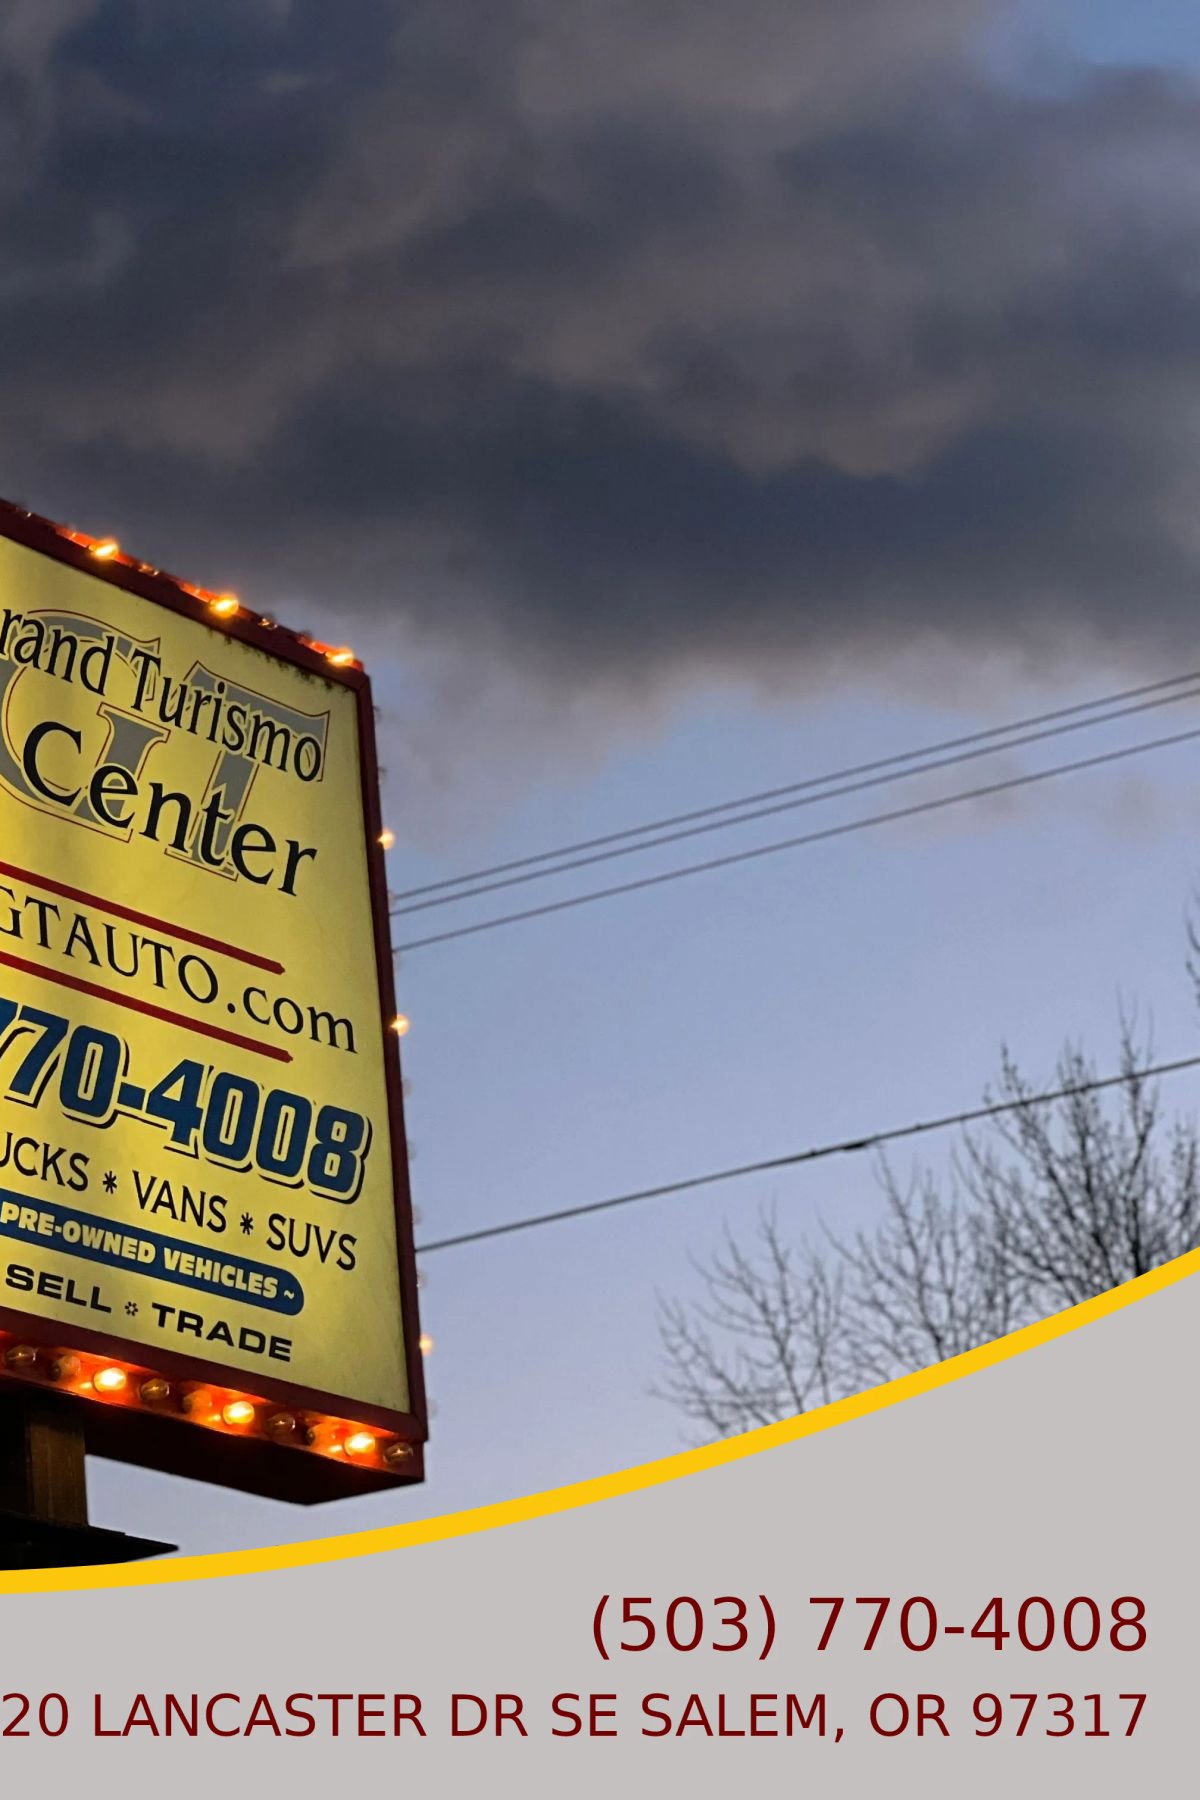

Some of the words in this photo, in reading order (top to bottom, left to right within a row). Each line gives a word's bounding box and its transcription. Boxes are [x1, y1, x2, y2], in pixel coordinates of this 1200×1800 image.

[129, 648, 323, 782] Turismo
[22, 721, 317, 897] Center
[0, 1201, 156, 1265] PRE-OWNED
[162, 1247, 279, 1298] VEHICLES
[133, 1171, 227, 1234] VANS
[266, 1215, 357, 1271] SUVS
[5, 1264, 112, 1313] SELL
[152, 1304, 292, 1362] TRADE
